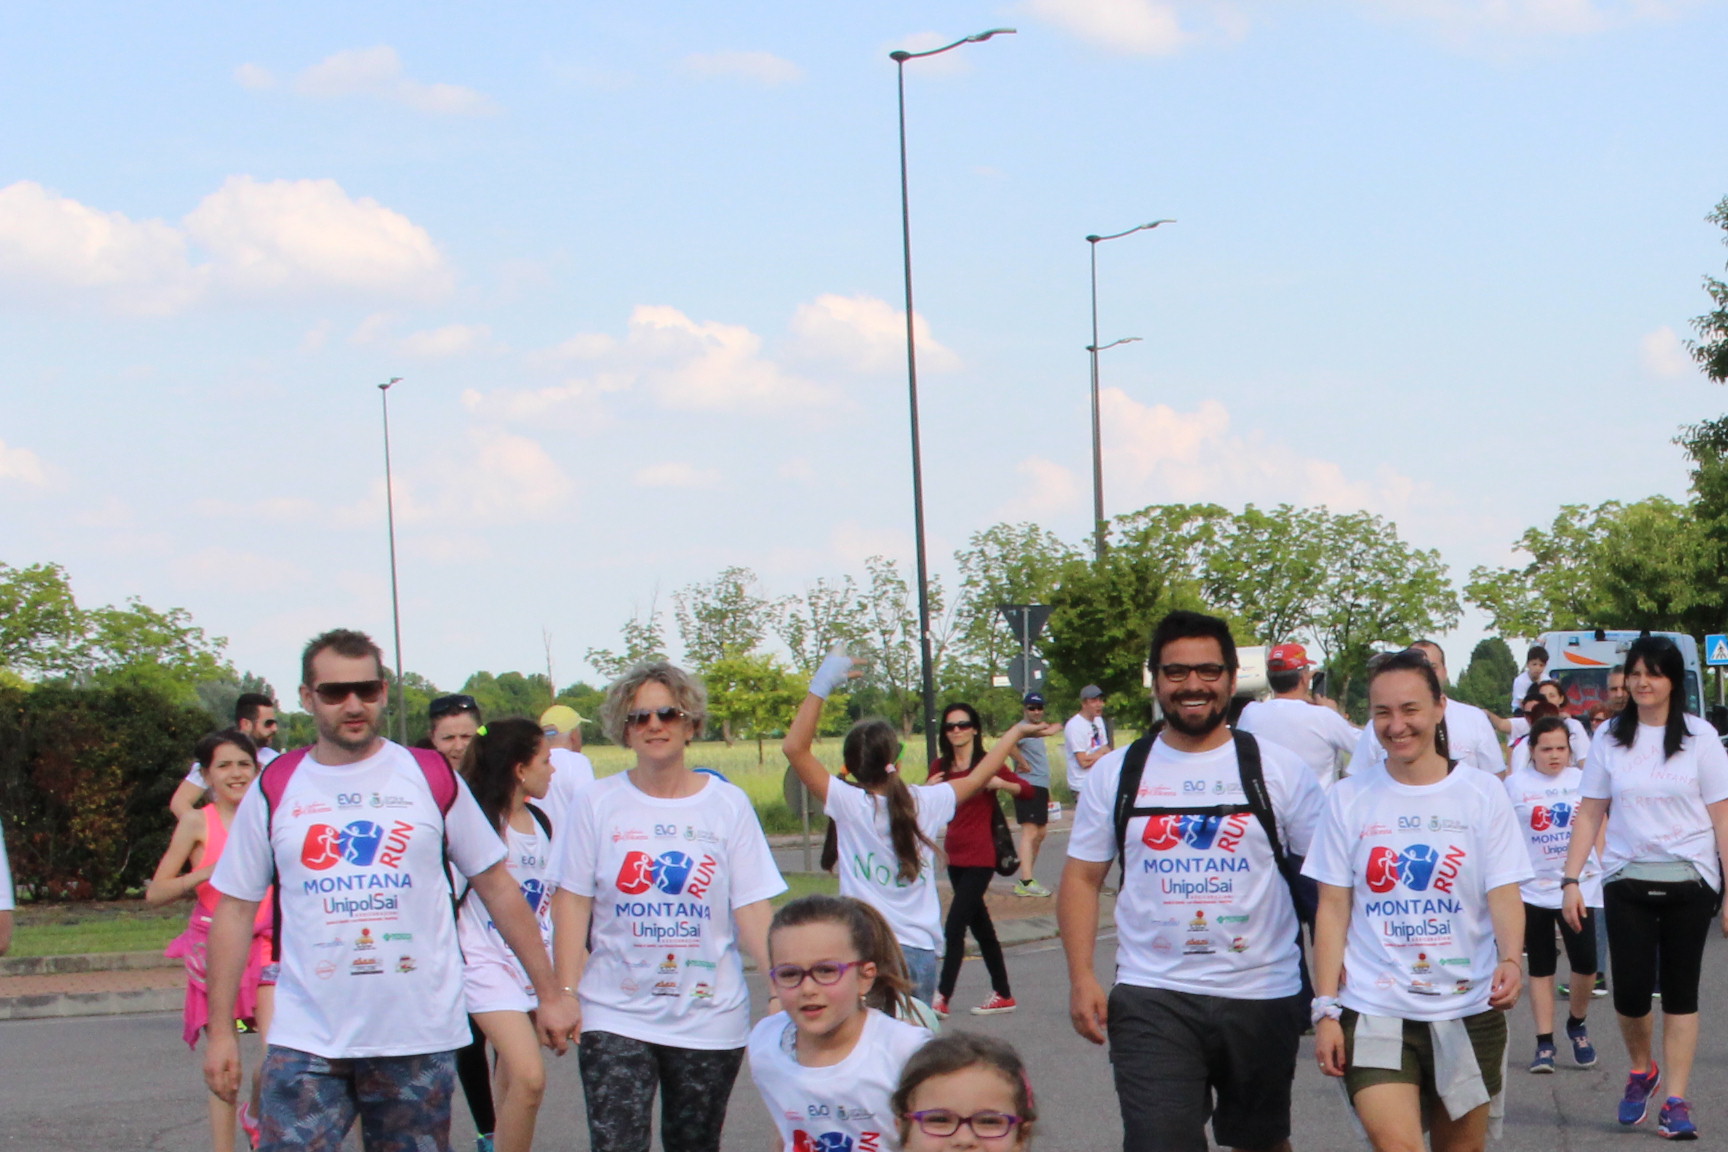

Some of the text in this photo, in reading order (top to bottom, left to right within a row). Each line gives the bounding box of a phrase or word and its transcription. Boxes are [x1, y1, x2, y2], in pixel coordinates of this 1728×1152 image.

[1183, 780, 1206, 792] EVO
[337, 793, 362, 805] EVO
[654, 824, 677, 836] EVO
[1398, 816, 1421, 829] EVO
[379, 820, 415, 869] RUN
[1531, 831, 1572, 845] MONTA
[1144, 858, 1251, 873] MONTANA
[1433, 844, 1467, 894] RUN
[303, 872, 413, 896] MONTANA
[687, 854, 719, 900] RUN
[1161, 877, 1233, 899] UnipolSai
[323, 892, 398, 917] UnipolSai
[615, 902, 711, 920] MONTANA
[1366, 898, 1465, 918] MONTANA
[633, 921, 701, 942] UnipolSai
[1384, 918, 1451, 942] UnipolSai
